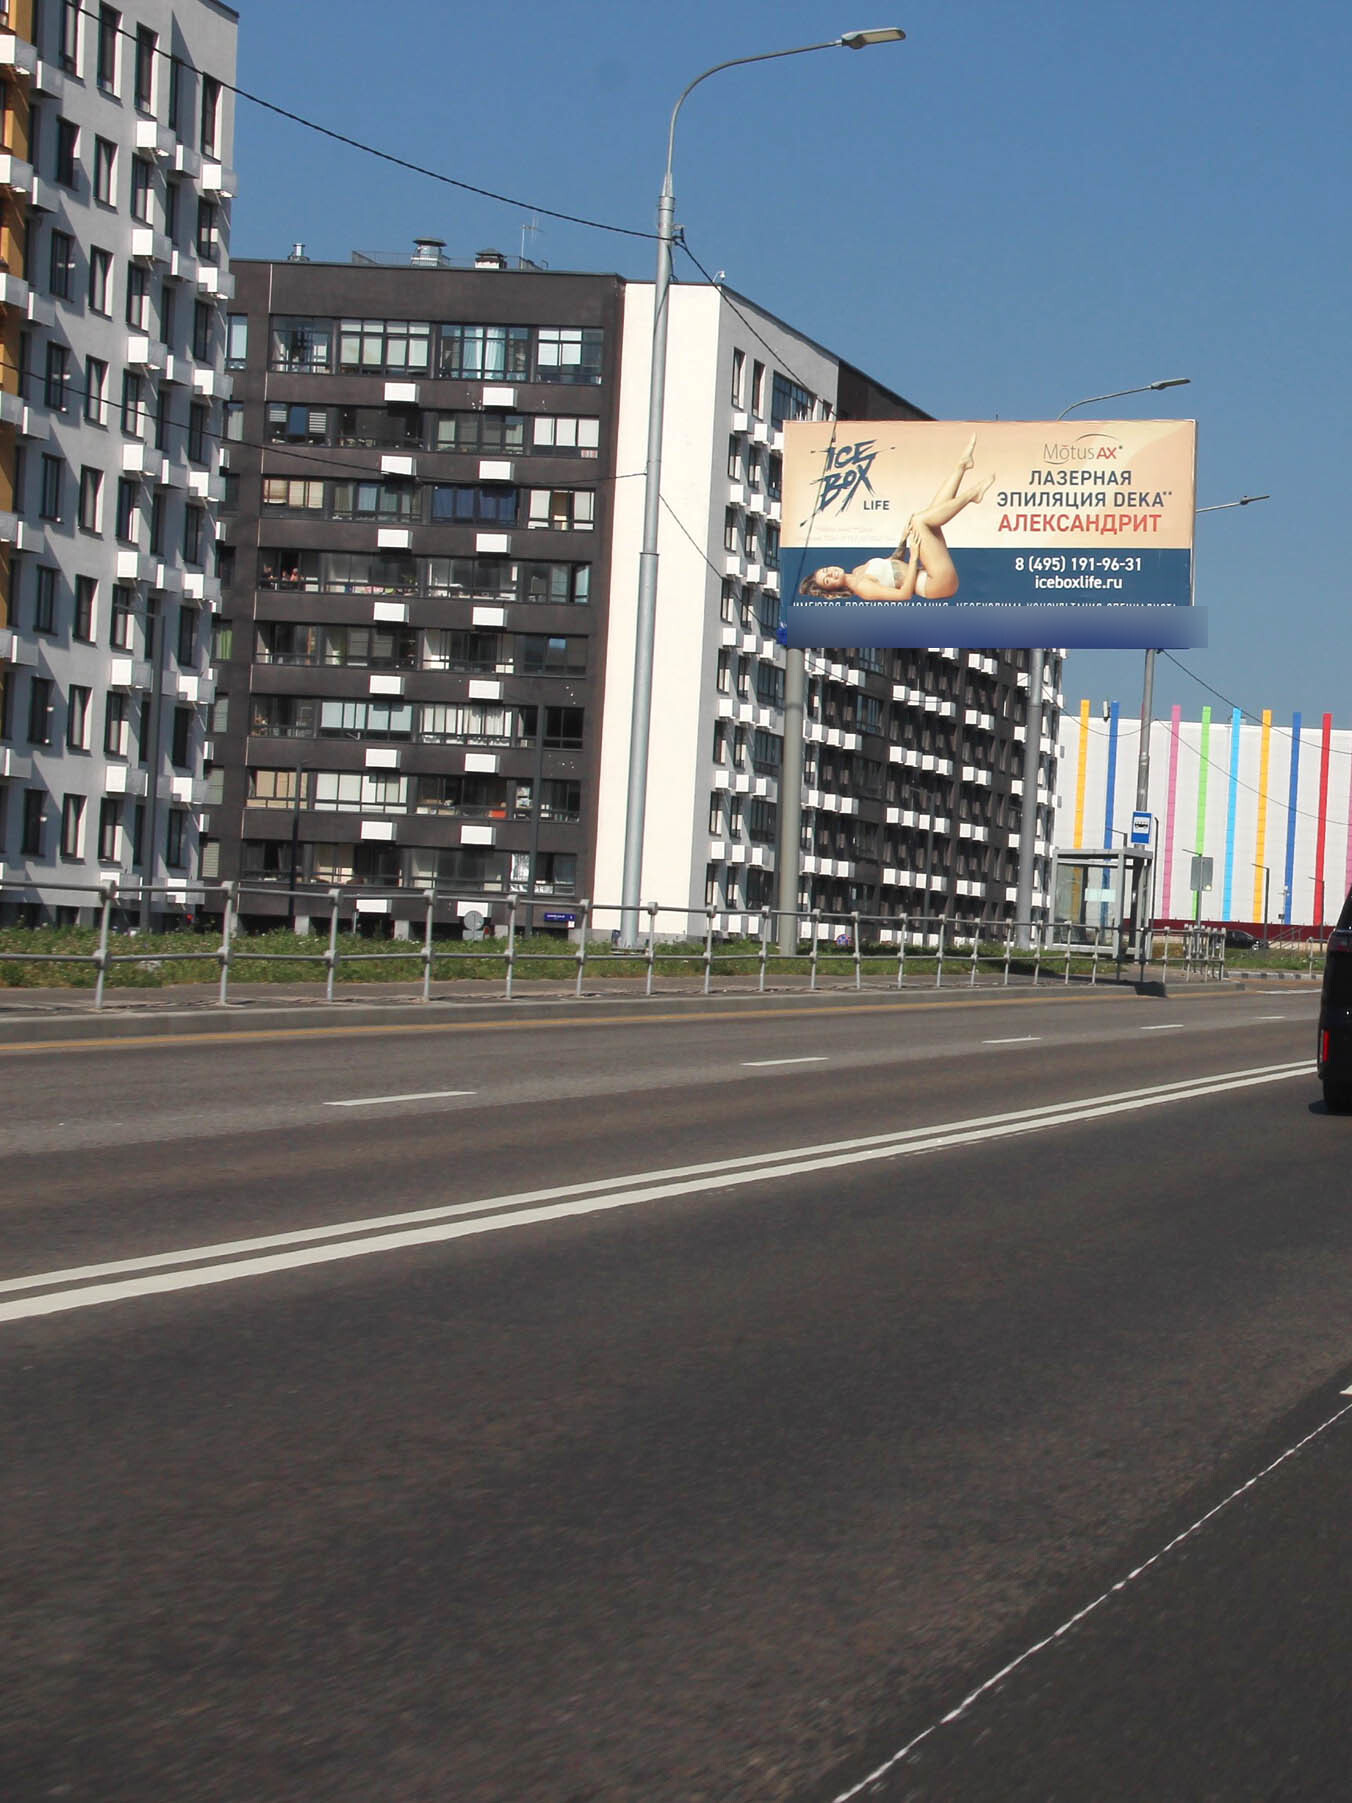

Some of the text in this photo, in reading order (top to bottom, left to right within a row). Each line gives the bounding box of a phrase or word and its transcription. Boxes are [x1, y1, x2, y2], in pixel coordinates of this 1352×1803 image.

[826, 439, 878, 471] ICE
[813, 453, 877, 513] BOX
[1029, 470, 1132, 486] ЛАЗЕРНАЯ
[863, 500, 890, 510] LIFE
[996, 491, 1106, 509] ЭПИЛЯЦИЯ
[998, 514, 1162, 535] АЛЕКСАНДРИТ
[1015, 555, 1142, 573] 8 (495) 191-96-31
[1035, 575, 1123, 589] iceboxlife.ru
